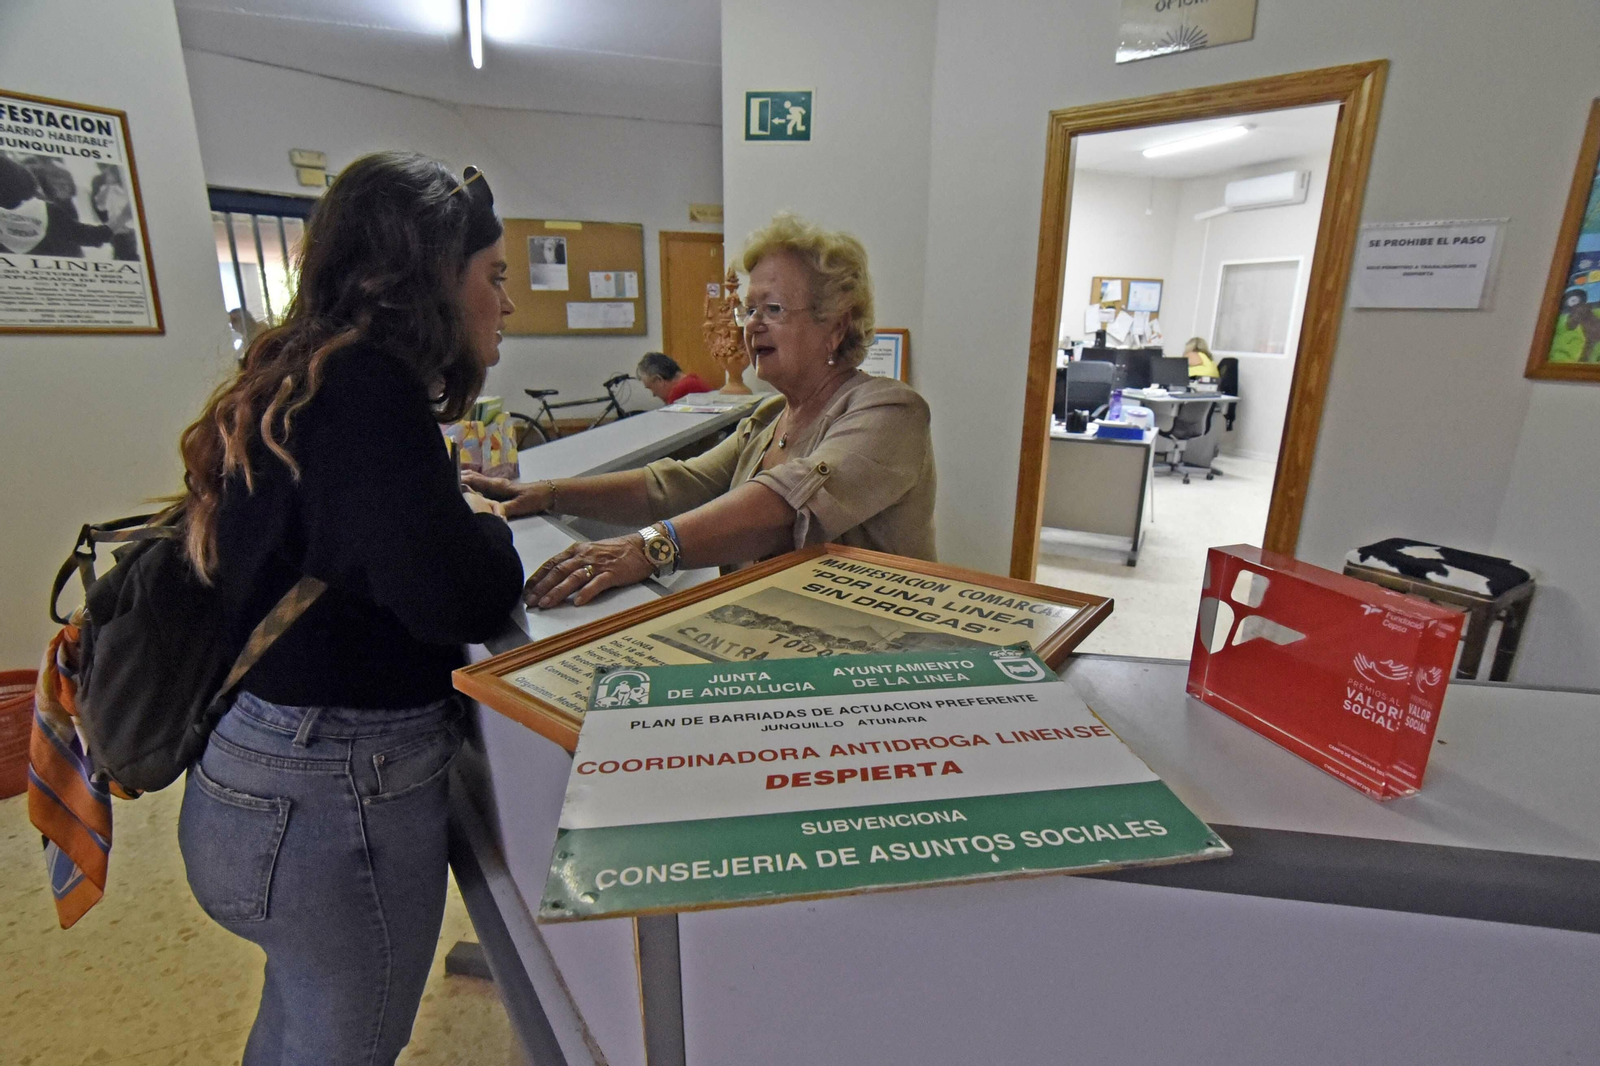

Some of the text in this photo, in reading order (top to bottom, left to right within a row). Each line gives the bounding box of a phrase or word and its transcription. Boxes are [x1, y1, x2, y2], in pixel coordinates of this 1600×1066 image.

[1369, 235, 1486, 247] SE PROHIBE EL PASO
[30, 259, 138, 274] LINEA
[819, 558, 1063, 618] MANIFESTACION COMARCAL
[802, 582, 1002, 634] SIN DROGAS"
[874, 587, 935, 606] UNA
[942, 601, 1035, 629] LINEA
[631, 639, 654, 651] LINEA
[677, 627, 769, 660] CONTRA
[708, 659, 975, 683] JUNTA AYUNTAMIENTO
[667, 672, 970, 700] DE ANDALUCIA DE LA LINEA
[1347, 678, 1387, 701] PREMIOS
[1389, 696, 1401, 707] AL
[631, 693, 1039, 730] PLAN DE BARRIADAS DE ACTUACION PREFERENTE
[1342, 699, 1395, 733] SOCIAL
[1346, 686, 1399, 720] VALOR
[1408, 702, 1431, 722] VALOR
[760, 715, 927, 732] JUNQUILLO ATUNARA
[1404, 716, 1427, 735] SOCIAL
[577, 724, 1112, 776] COORDINADORA ANTIDROGA LINENSE
[765, 760, 964, 790] DESPIERTA
[801, 809, 967, 835] SUBVENCIONA
[594, 819, 1168, 889] CONSEJERIA DE ASUNTOS SOCIALES
